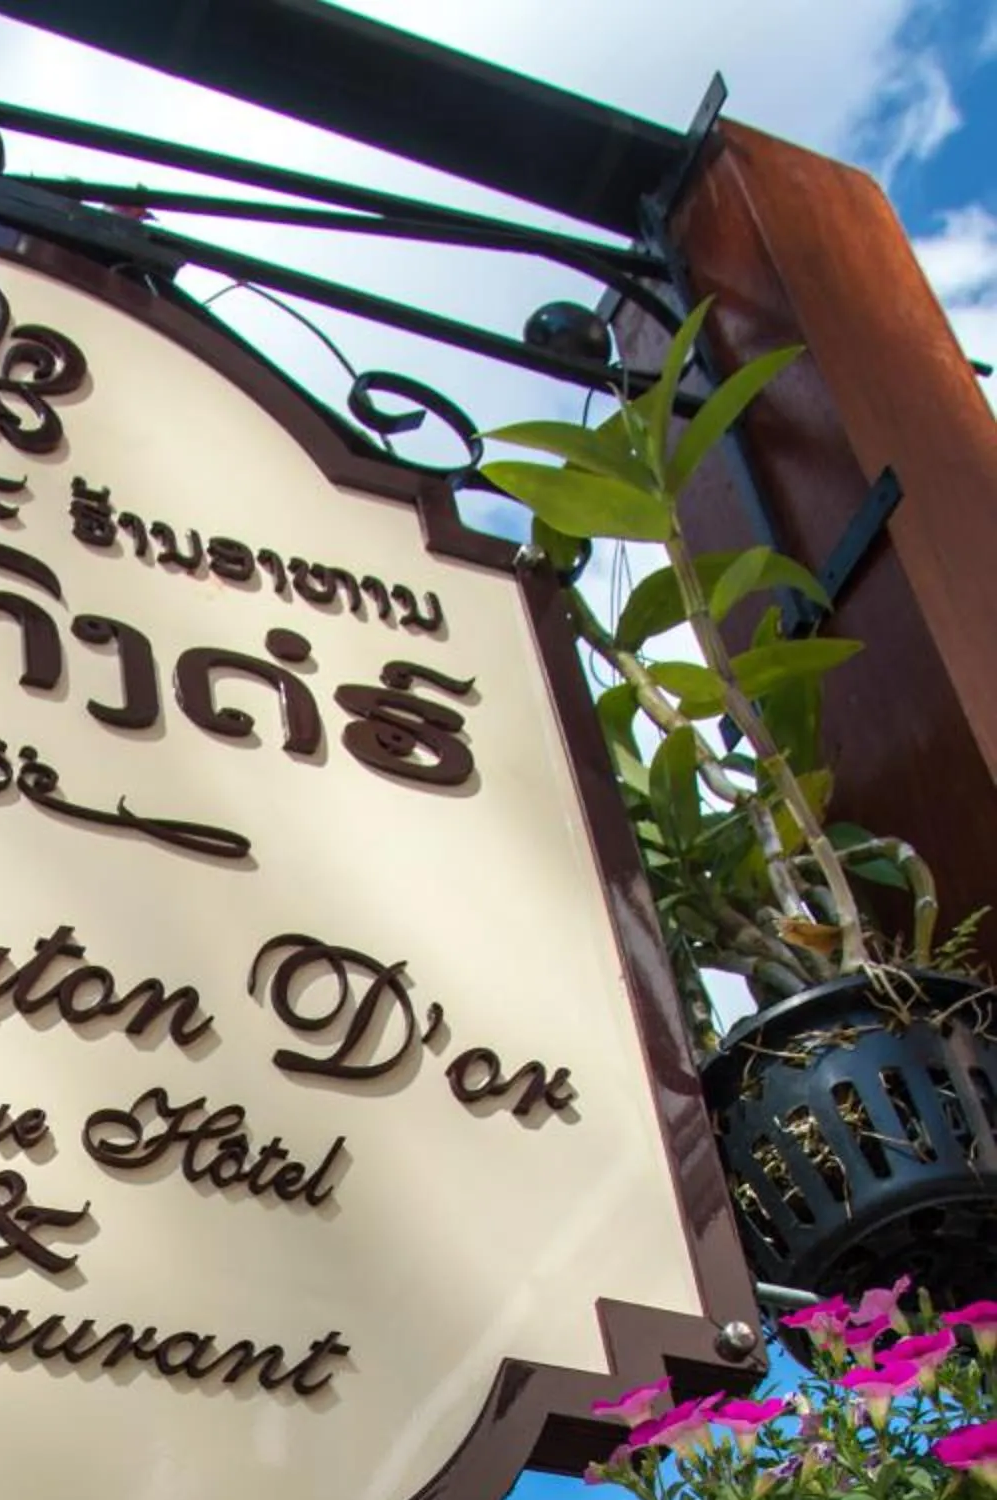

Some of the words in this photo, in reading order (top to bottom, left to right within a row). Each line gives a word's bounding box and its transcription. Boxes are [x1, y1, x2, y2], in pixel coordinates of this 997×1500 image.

[69, 477, 443, 634] ຮ້ານອາຫານ
[248, 933, 576, 1119] D'or
[83, 1087, 346, 1210] Hôtel
